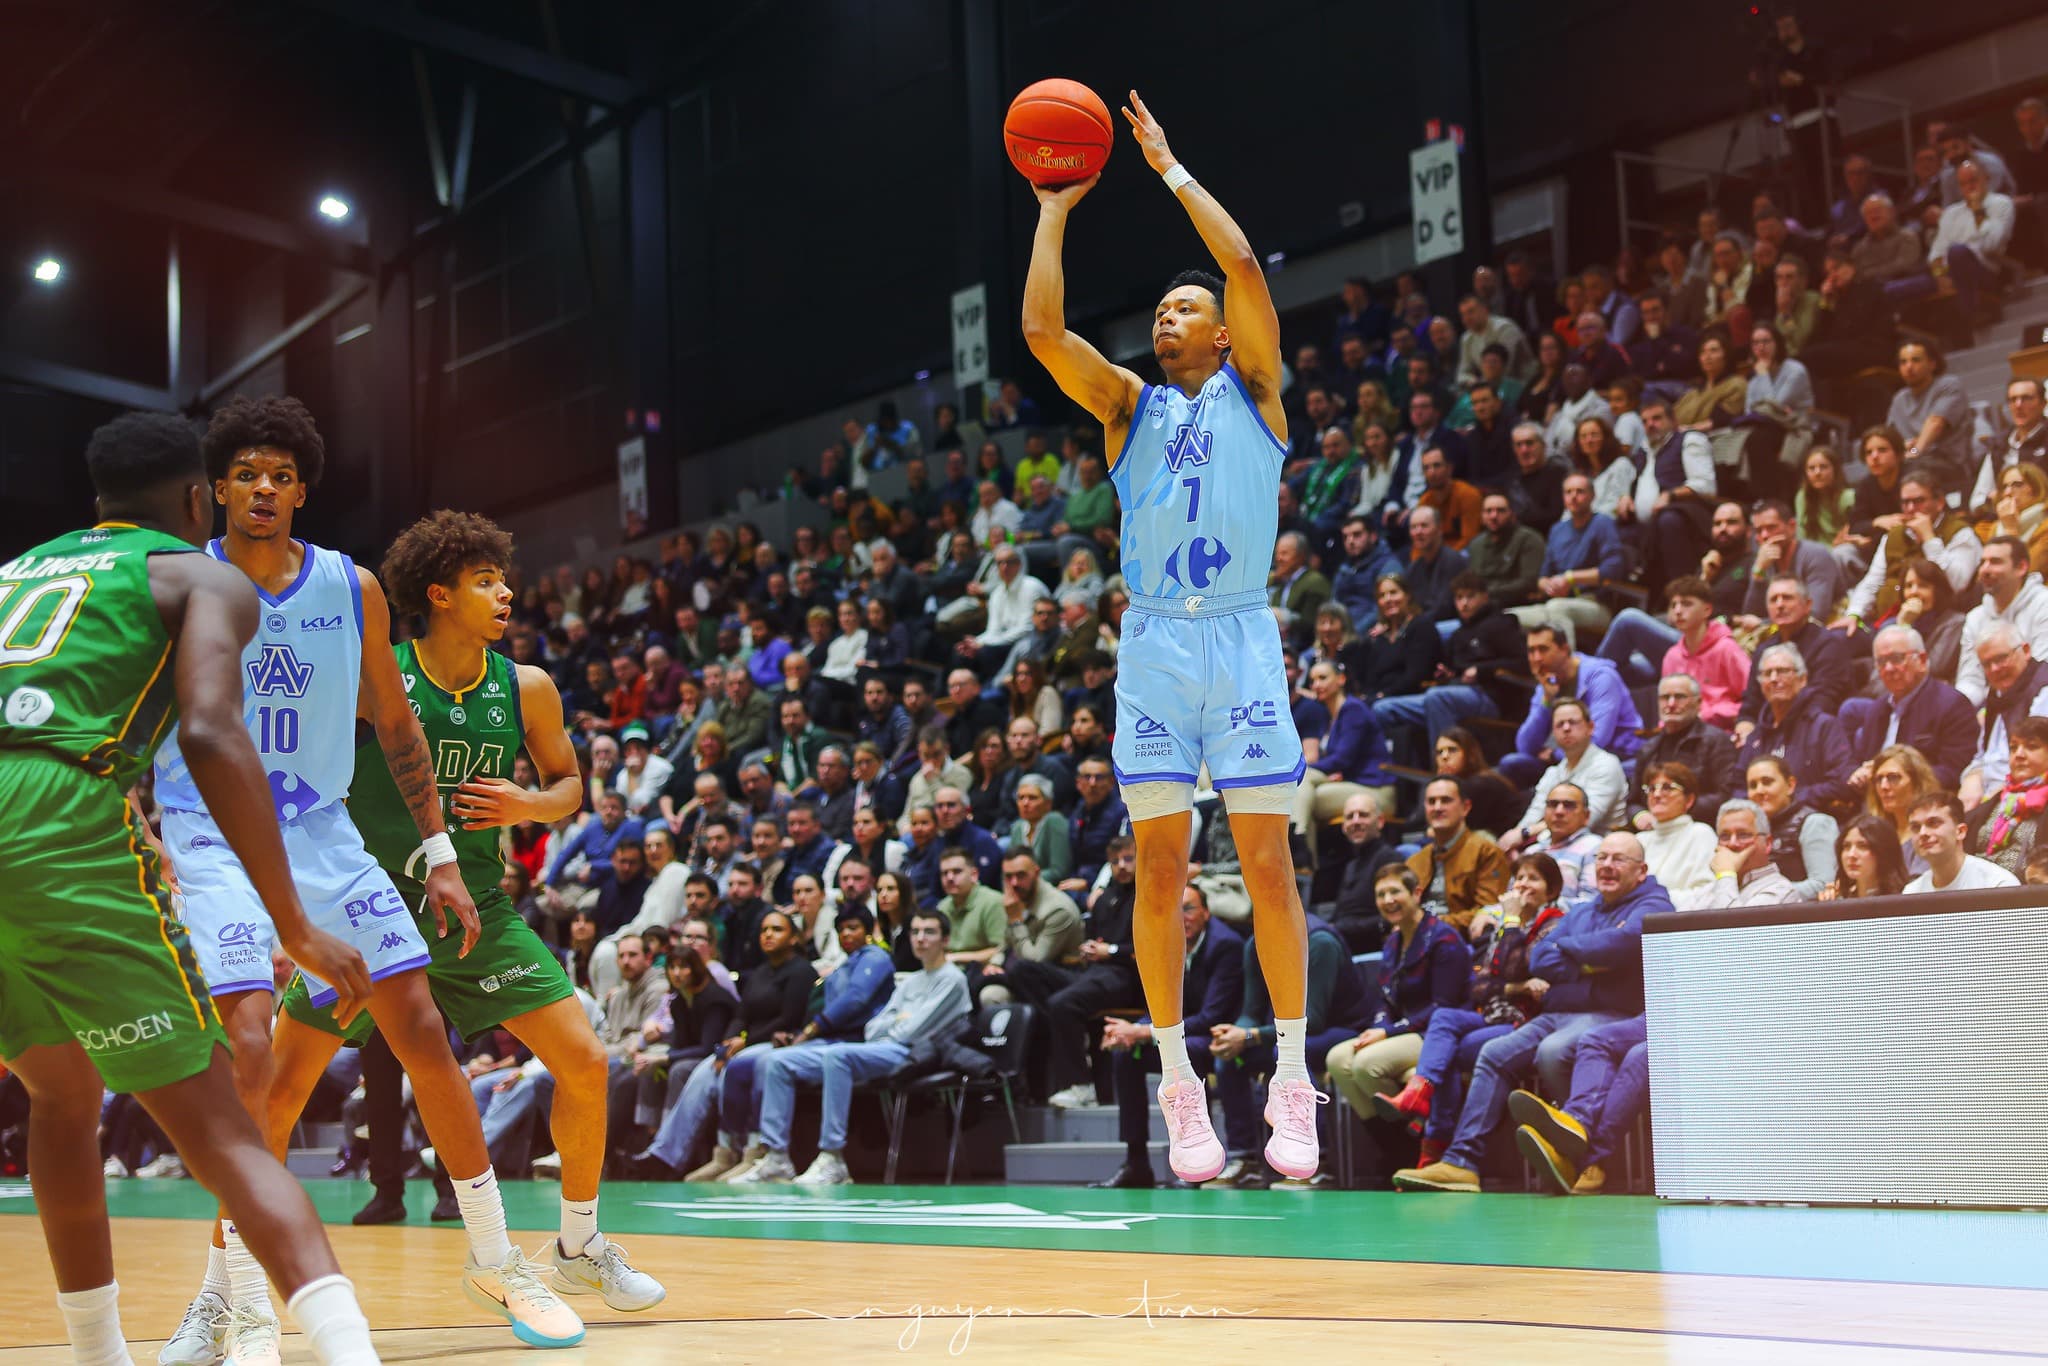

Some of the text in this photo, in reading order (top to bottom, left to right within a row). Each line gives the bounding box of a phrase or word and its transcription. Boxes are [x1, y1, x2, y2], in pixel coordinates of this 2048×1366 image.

[1416, 162, 1454, 195] VIP
[1419, 210, 1457, 245] D C
[257, 705, 300, 755] 10
[1135, 742, 1172, 751] CENTRE
[1135, 749, 1173, 758] FRANCE
[219, 949, 256, 959] CENT
[75, 1010, 174, 1050] SCHOEN
